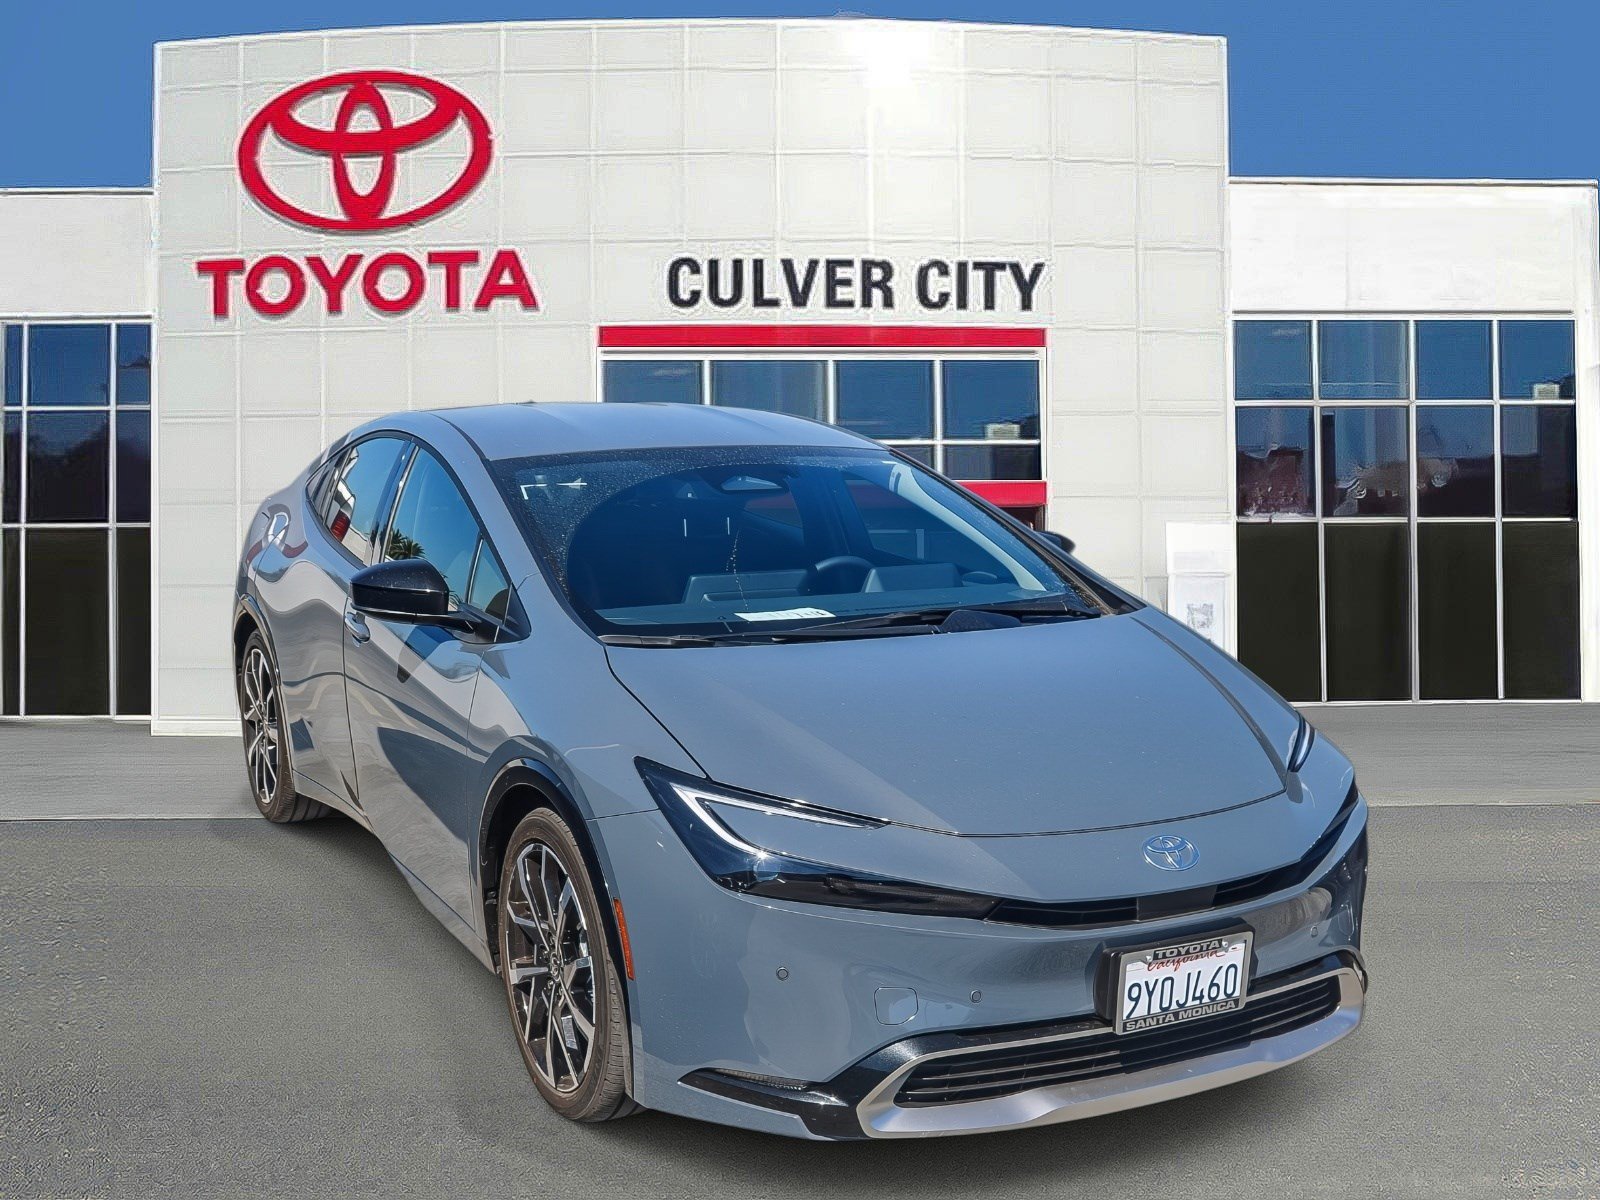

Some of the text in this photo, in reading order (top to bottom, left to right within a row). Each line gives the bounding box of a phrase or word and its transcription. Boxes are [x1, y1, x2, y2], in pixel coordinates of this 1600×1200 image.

[197, 249, 539, 317] TOYOTA
[667, 257, 1046, 312] CULVER CITY
[1155, 940, 1220, 959] TOYOTA
[1126, 1000, 1236, 1031] SANTA MONICA
